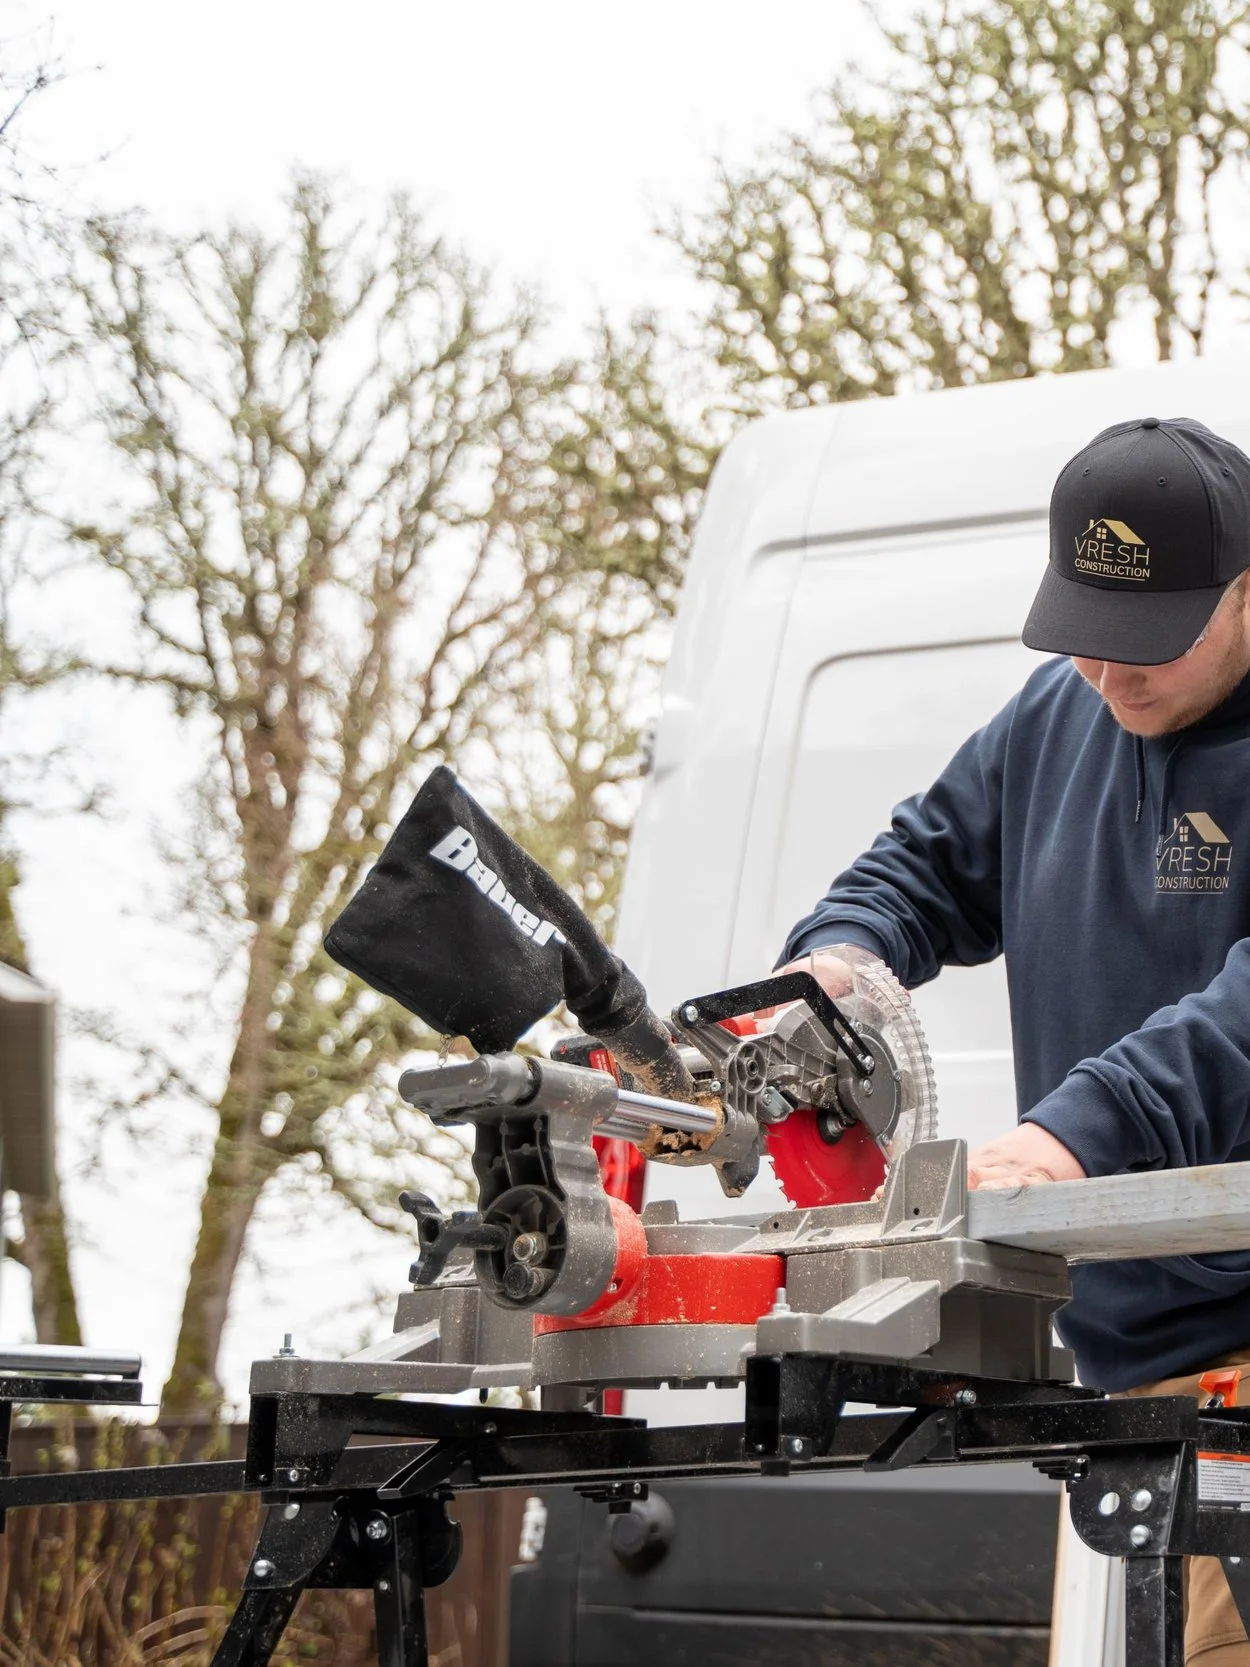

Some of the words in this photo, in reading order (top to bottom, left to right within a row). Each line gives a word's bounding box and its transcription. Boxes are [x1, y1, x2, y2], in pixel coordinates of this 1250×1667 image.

[1074, 536, 1150, 566] VRESH
[1074, 558, 1151, 578] CONSTRUCTION
[1154, 845, 1233, 872] VRESH
[429, 825, 567, 947] Bauer
[1154, 875, 1230, 890] CONSTRUCTION
